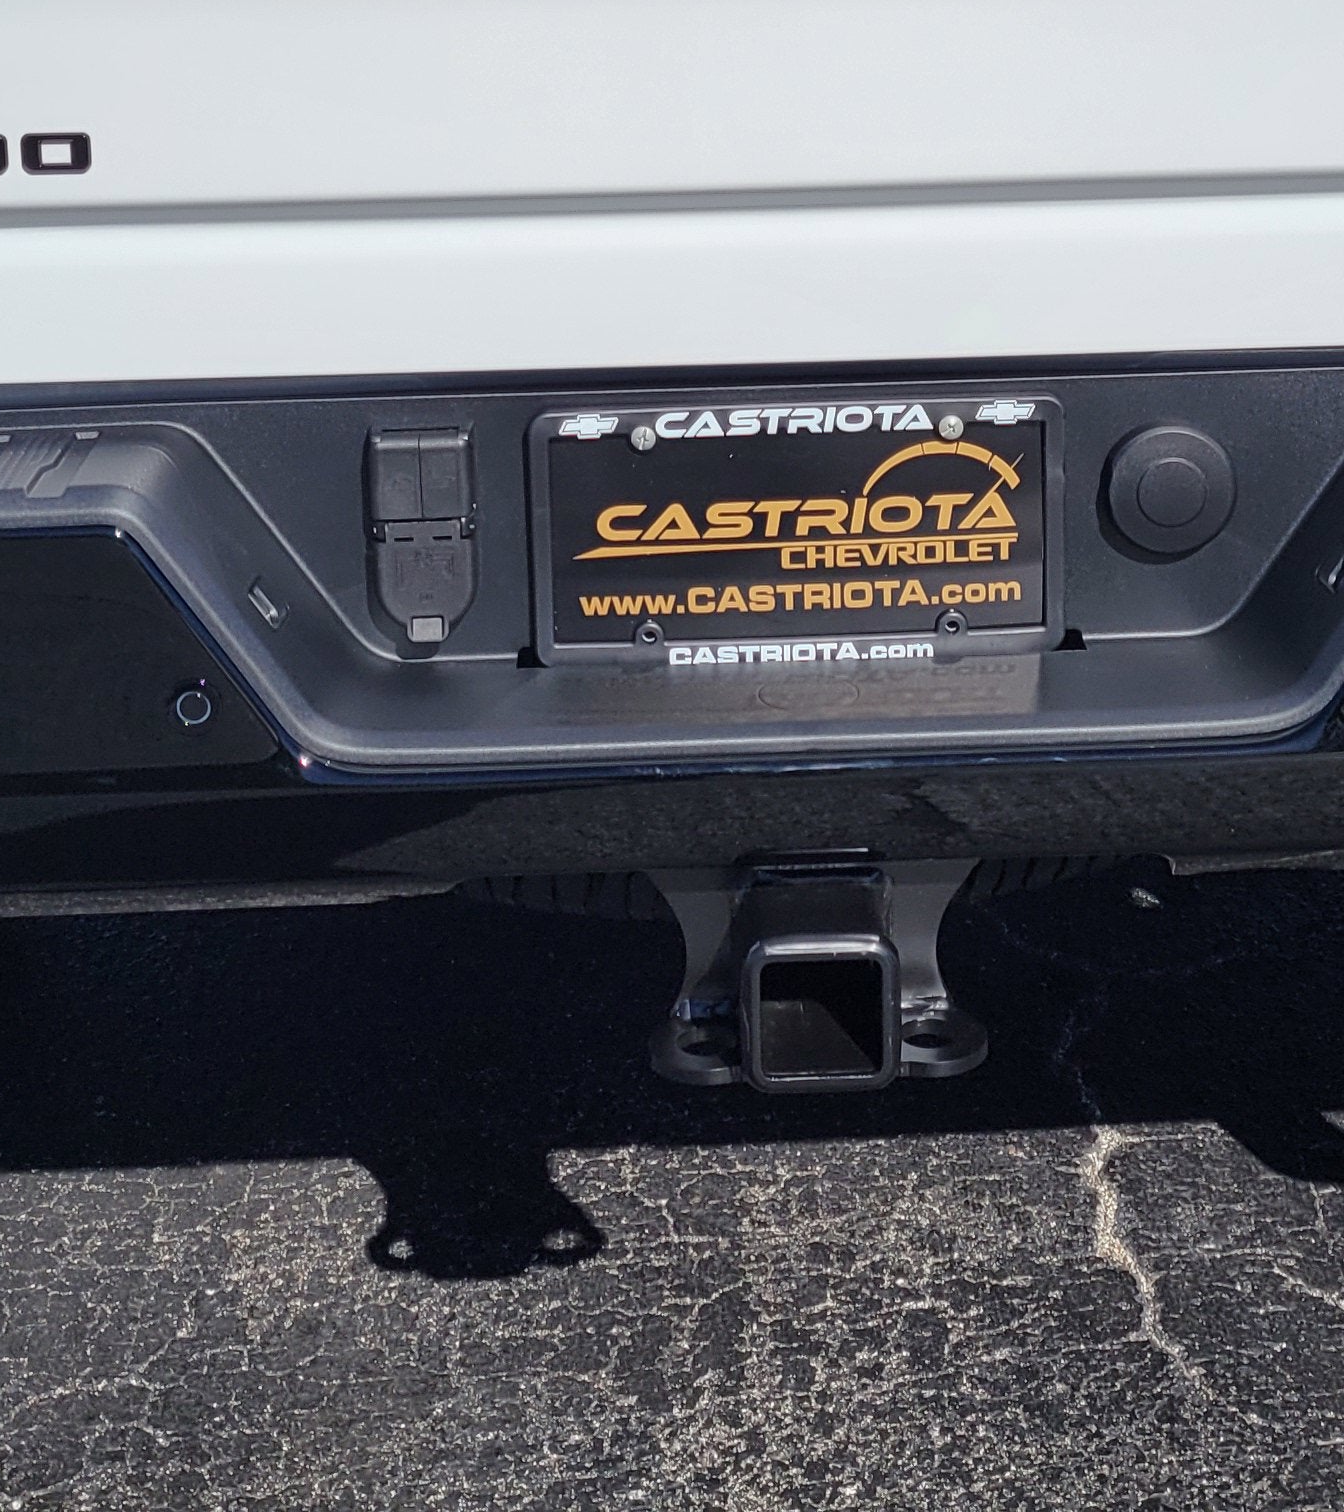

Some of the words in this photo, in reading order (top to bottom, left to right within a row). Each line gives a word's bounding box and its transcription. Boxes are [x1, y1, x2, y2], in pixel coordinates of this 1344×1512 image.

[655, 404, 934, 440] CASTRIOTA
[596, 490, 1017, 542] CASTRIOTA
[781, 537, 1017, 570] CHEVROLET
[579, 579, 1022, 616] www.CASTRIOTA.com
[668, 640, 935, 666] CASTRIOTA.com
